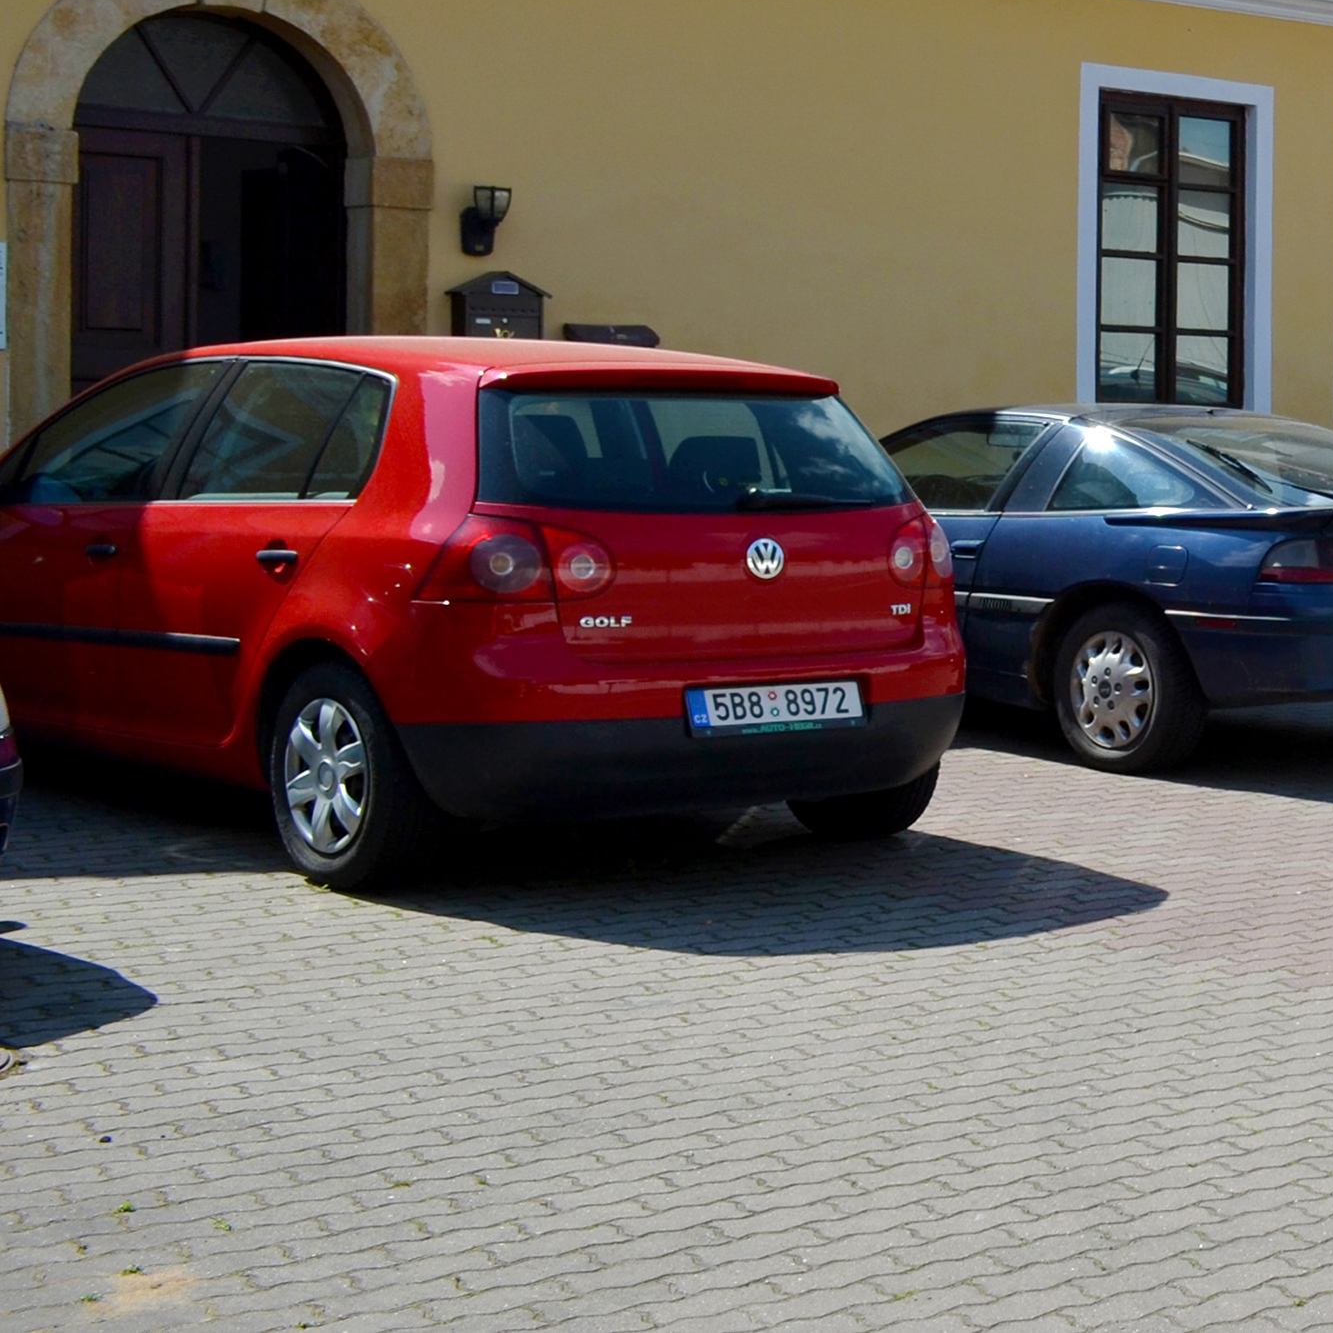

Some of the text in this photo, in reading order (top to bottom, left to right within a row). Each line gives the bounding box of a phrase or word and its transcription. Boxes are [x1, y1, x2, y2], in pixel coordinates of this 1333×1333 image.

[579, 616, 632, 629] GOLF
[712, 686, 850, 721] 5B8 8972
[693, 714, 708, 724] CZ
